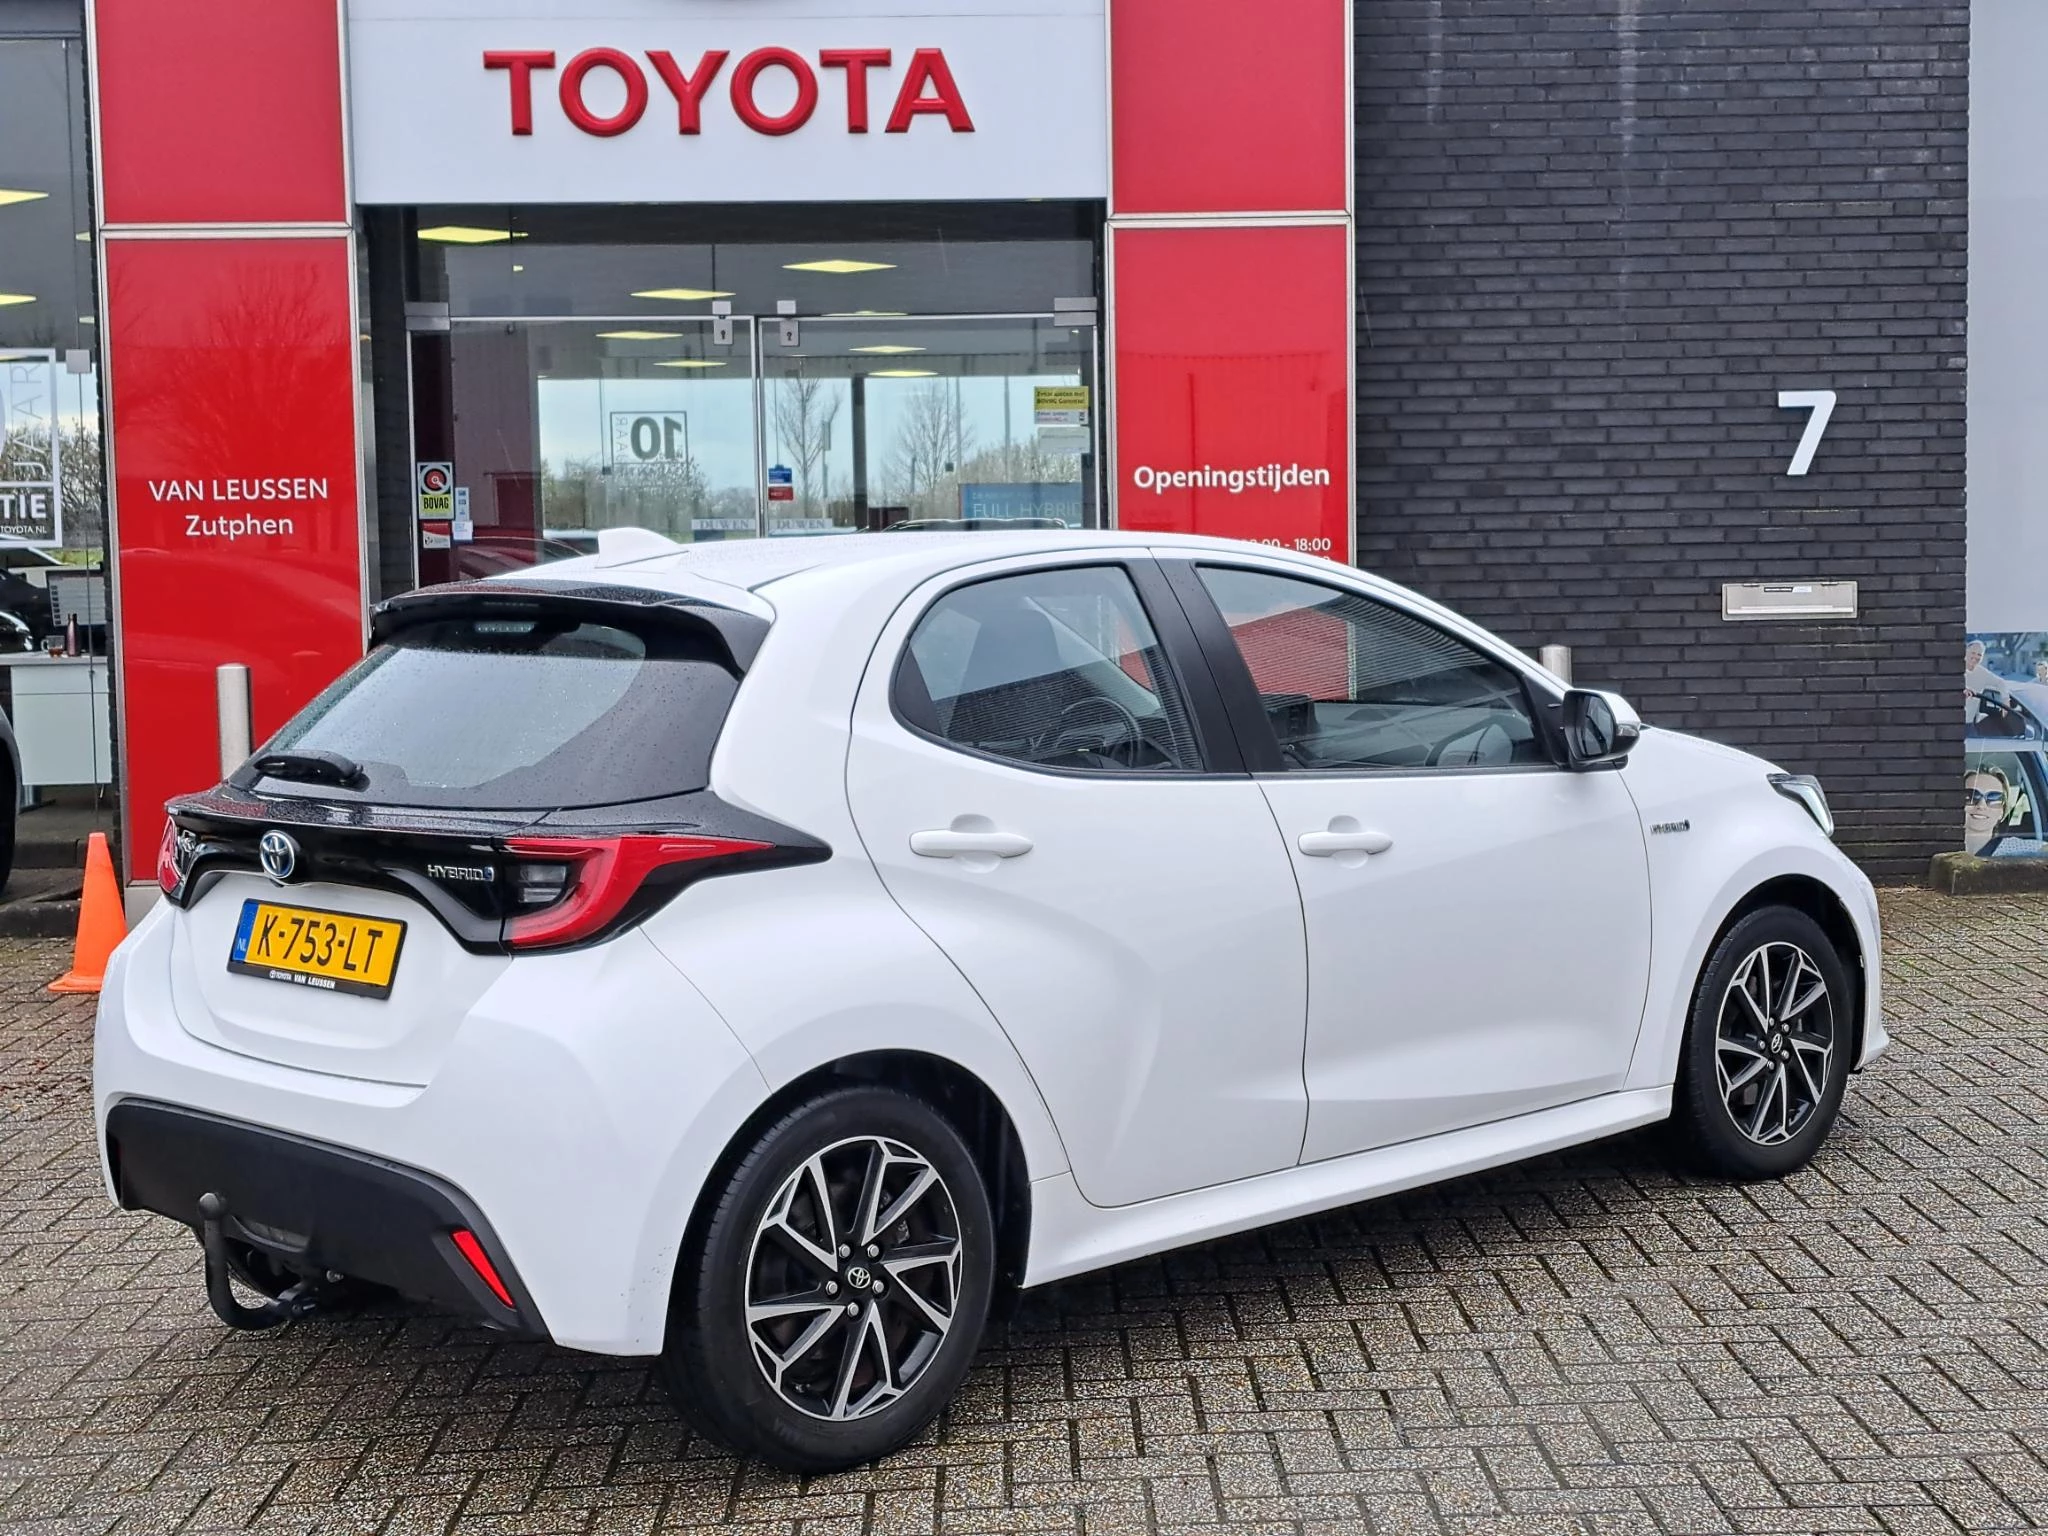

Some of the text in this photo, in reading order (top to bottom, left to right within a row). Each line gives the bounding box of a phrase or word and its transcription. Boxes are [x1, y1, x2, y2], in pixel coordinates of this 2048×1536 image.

[483, 46, 976, 137] TOYOTA
[12, 364, 46, 477] JAAR
[1779, 390, 1837, 475] 7
[1134, 463, 1330, 494] Openingstijden
[148, 478, 328, 501] VAN LEUSSEN
[423, 497, 449, 510] BOVAG
[973, 503, 1013, 518] FULL
[185, 513, 293, 541] Zutphen
[700, 520, 749, 529] DUWEN
[777, 519, 825, 529] DUWEN
[1294, 537, 1331, 551] 18:00
[427, 864, 484, 880] HYBRID
[237, 937, 247, 952] NL
[257, 913, 384, 974] K-753-LT
[294, 973, 307, 984] VAN
[307, 976, 336, 990] LEUSSEN
